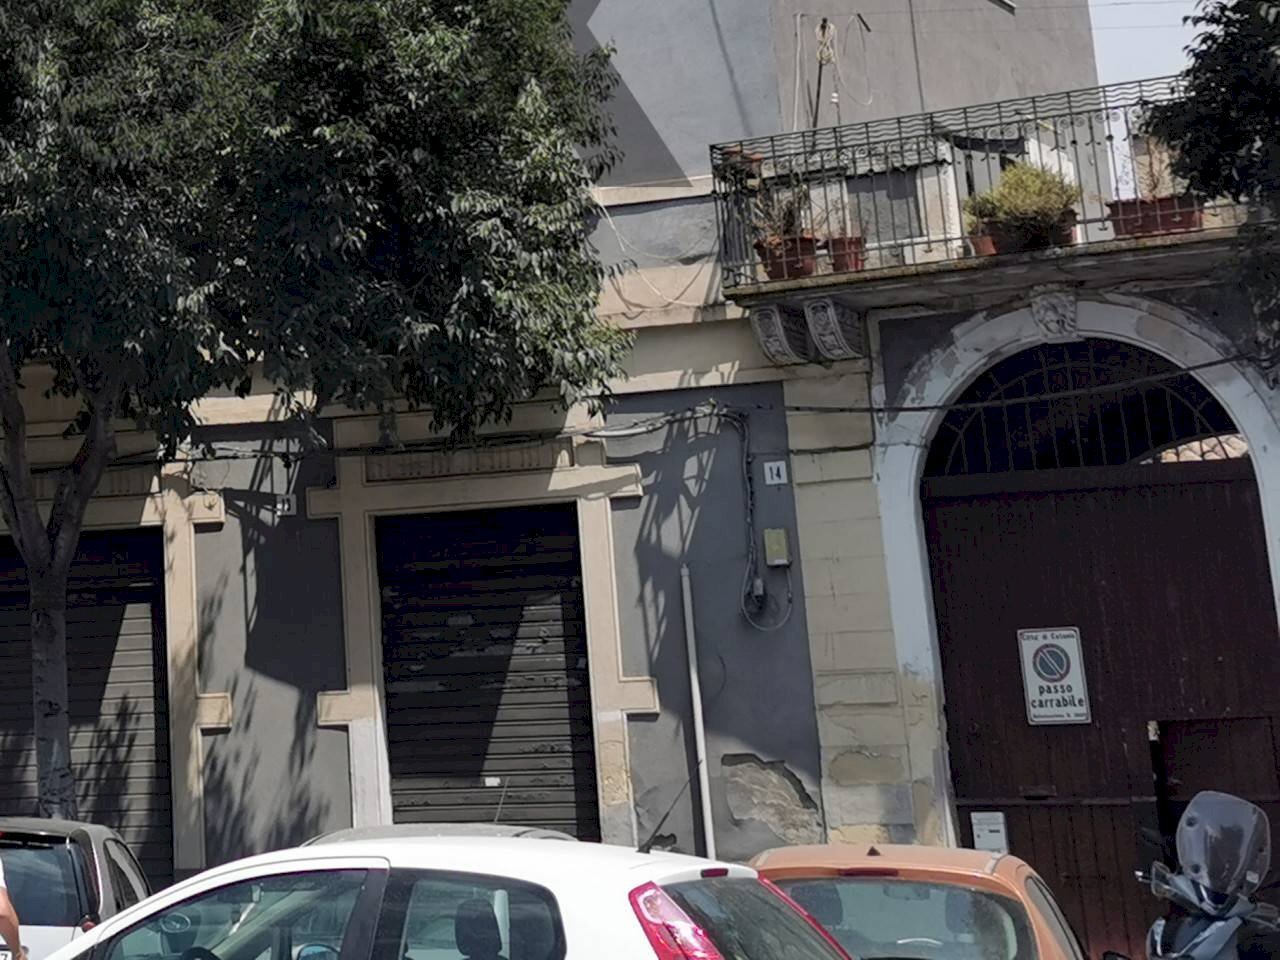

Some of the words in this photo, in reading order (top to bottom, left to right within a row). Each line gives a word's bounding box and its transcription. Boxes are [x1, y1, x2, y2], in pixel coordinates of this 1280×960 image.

[769, 466, 782, 480] 14
[1039, 684, 1073, 696] passo
[1031, 695, 1085, 708] carrabile
